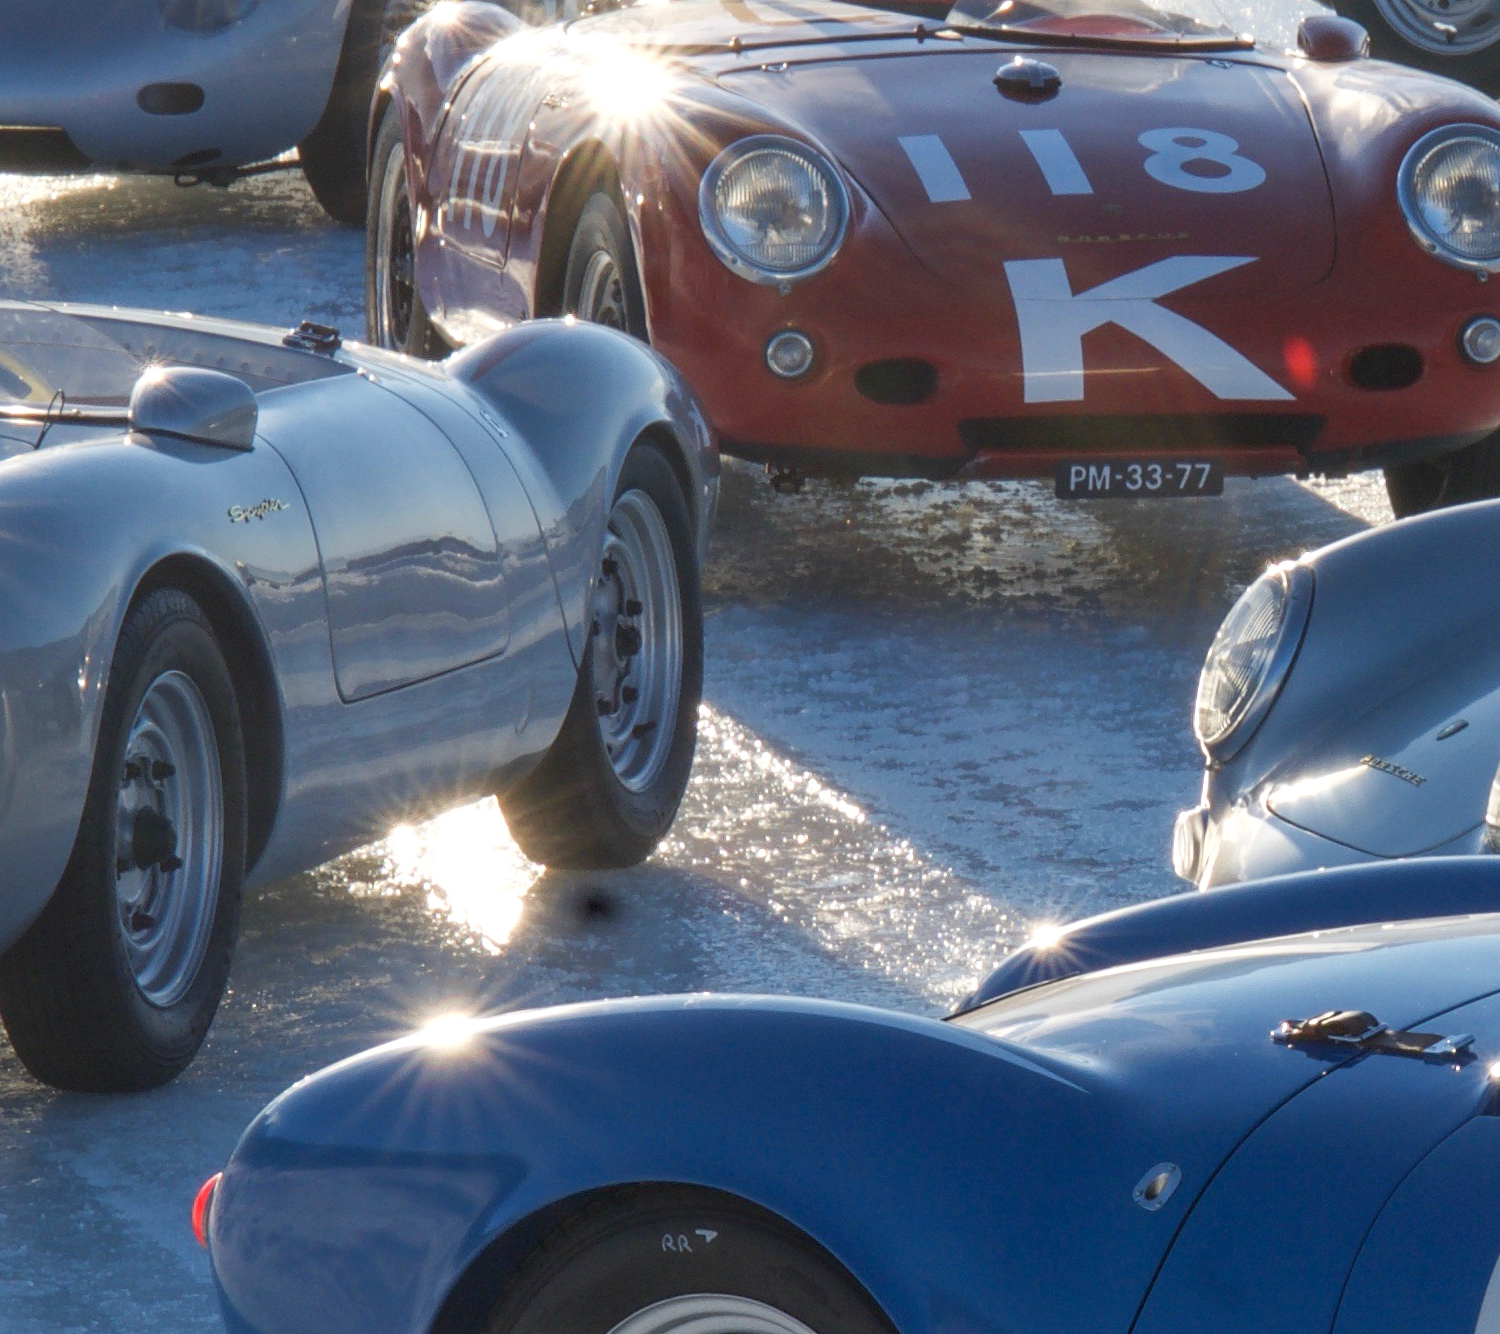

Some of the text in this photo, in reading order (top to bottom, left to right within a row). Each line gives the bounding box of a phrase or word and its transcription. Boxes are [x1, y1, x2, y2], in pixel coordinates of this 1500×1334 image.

[897, 127, 1266, 203] 118
[1003, 255, 1297, 403] K
[1069, 463, 1211, 491] PM-33-77
[662, 1234, 693, 1253] RR
